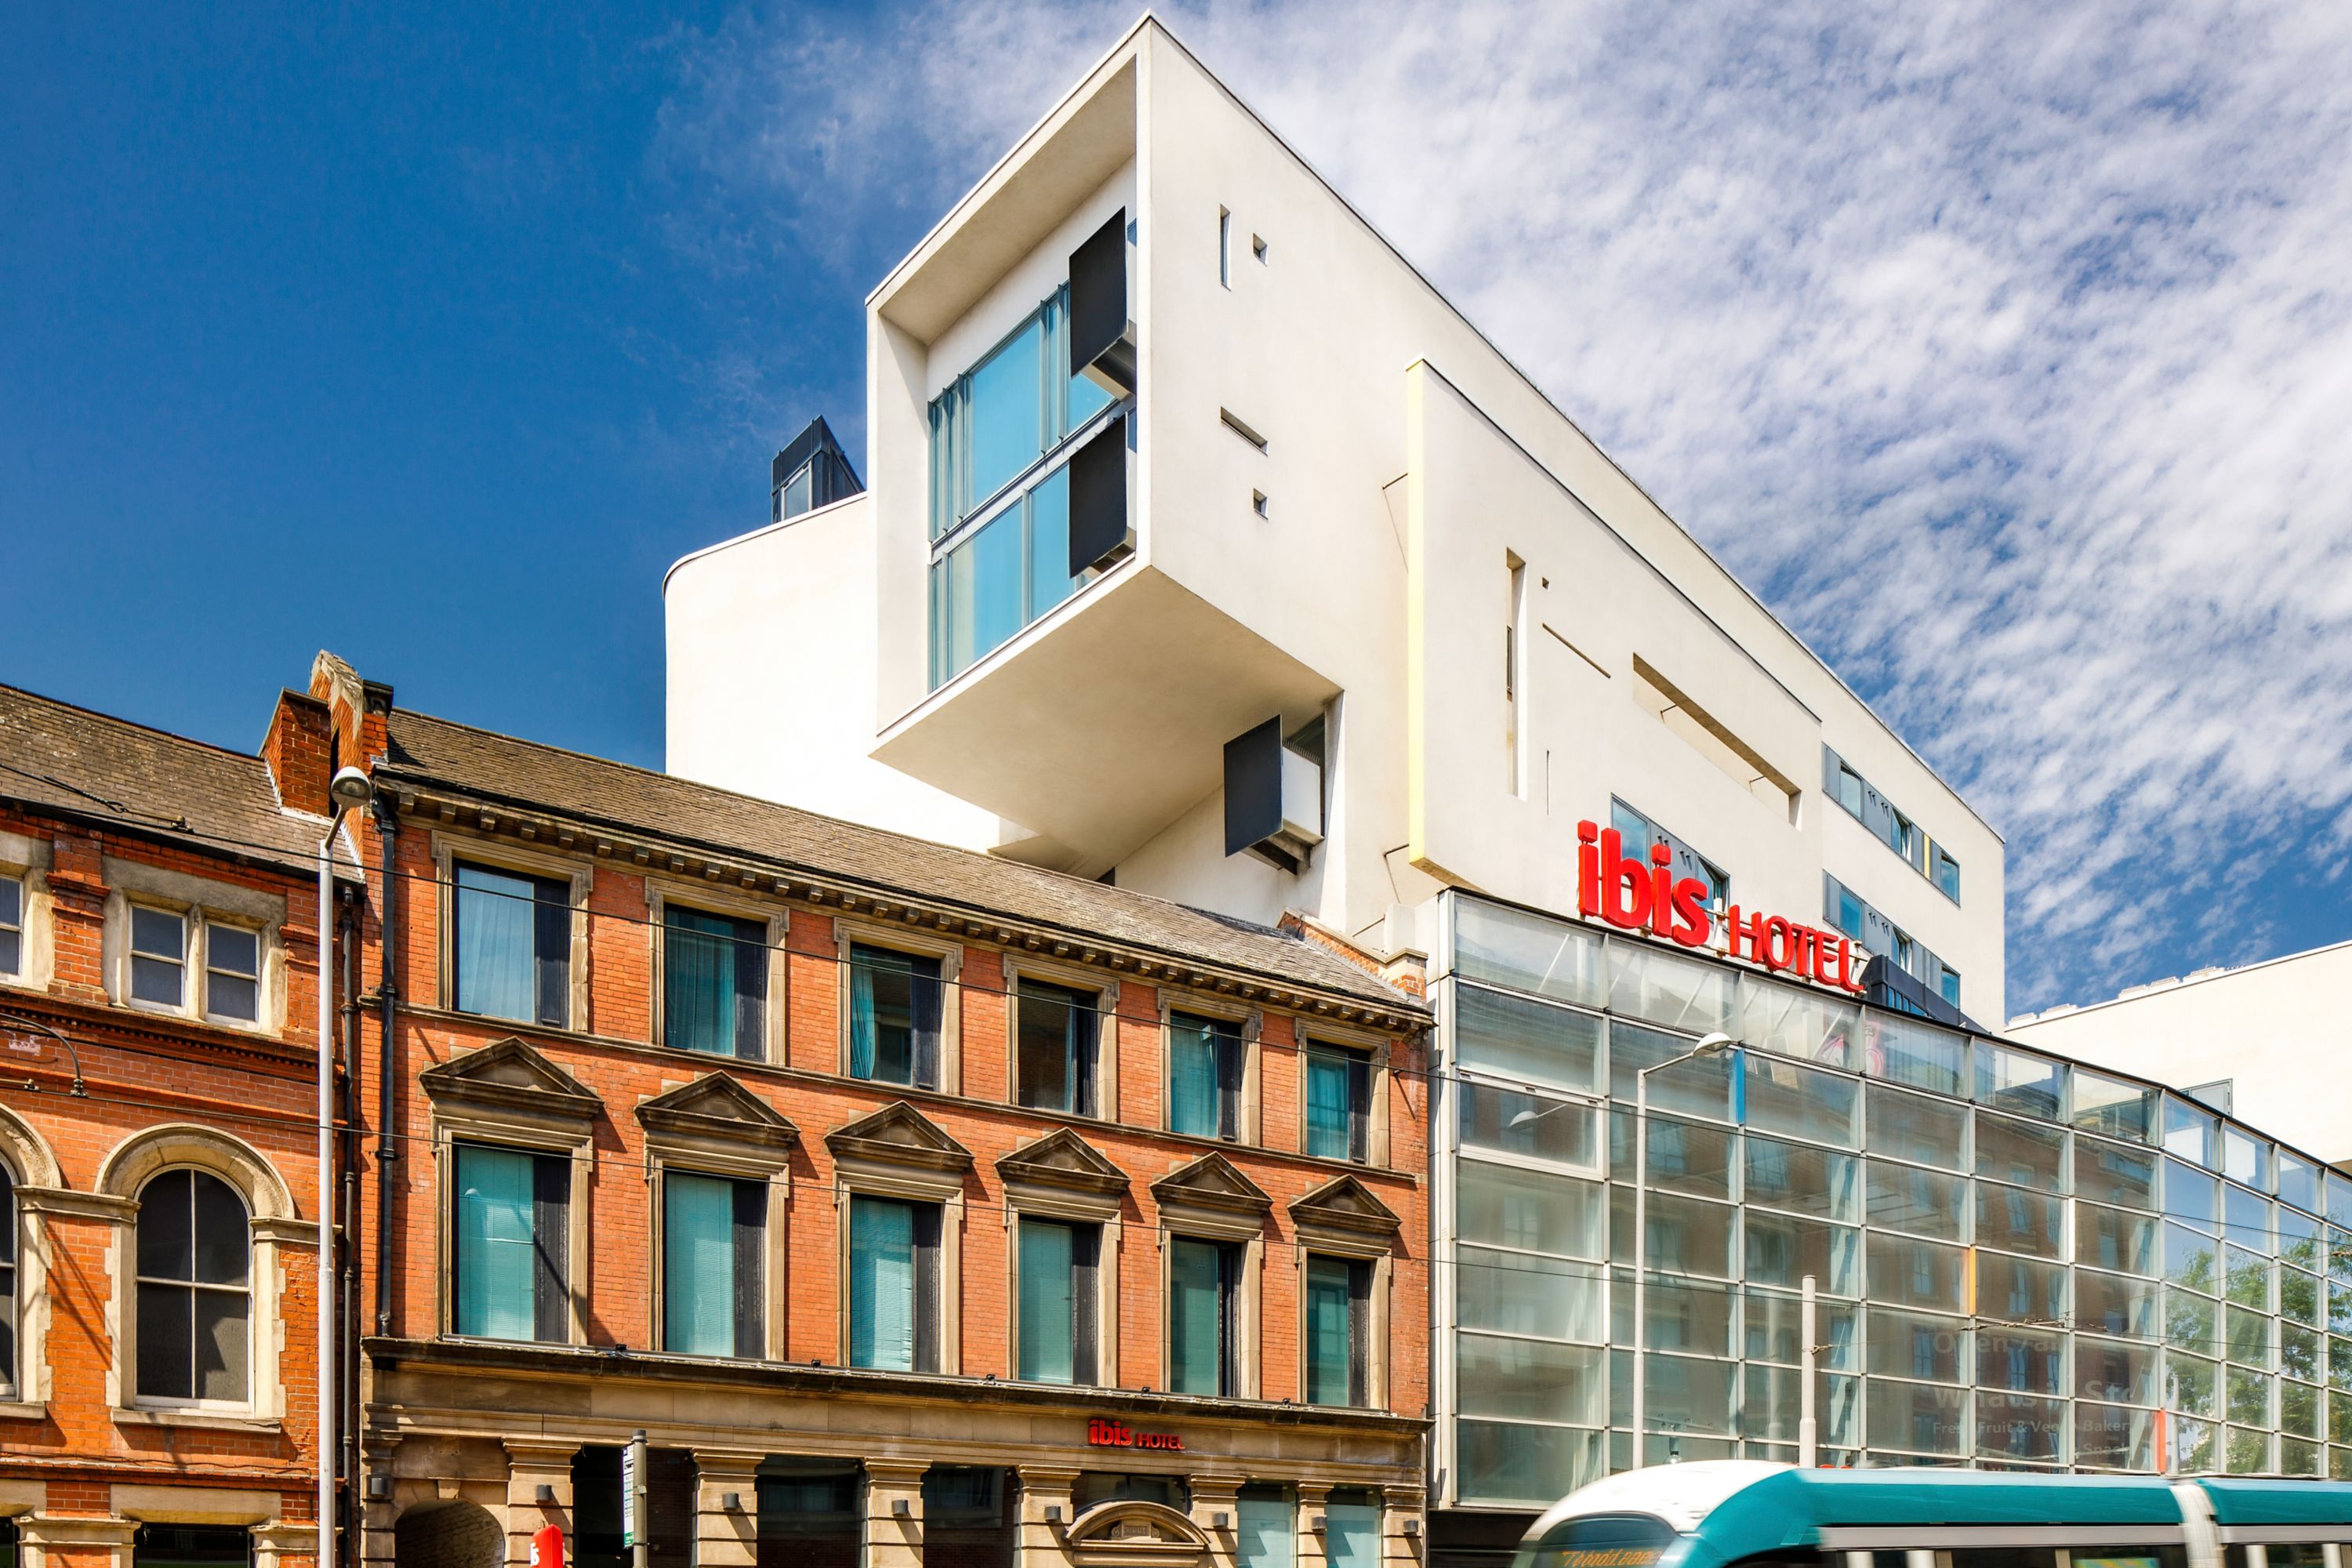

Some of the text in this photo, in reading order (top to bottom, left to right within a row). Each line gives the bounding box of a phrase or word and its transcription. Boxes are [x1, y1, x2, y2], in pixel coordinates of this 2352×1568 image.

[1577, 820, 1864, 993] ibis HOTEL
[1933, 1331, 2008, 1354] Oen
[1089, 1419, 1185, 1450] ibis HOTEL
[1977, 1421, 2013, 1433] Fruit
[2083, 1419, 2130, 1433] Baker
